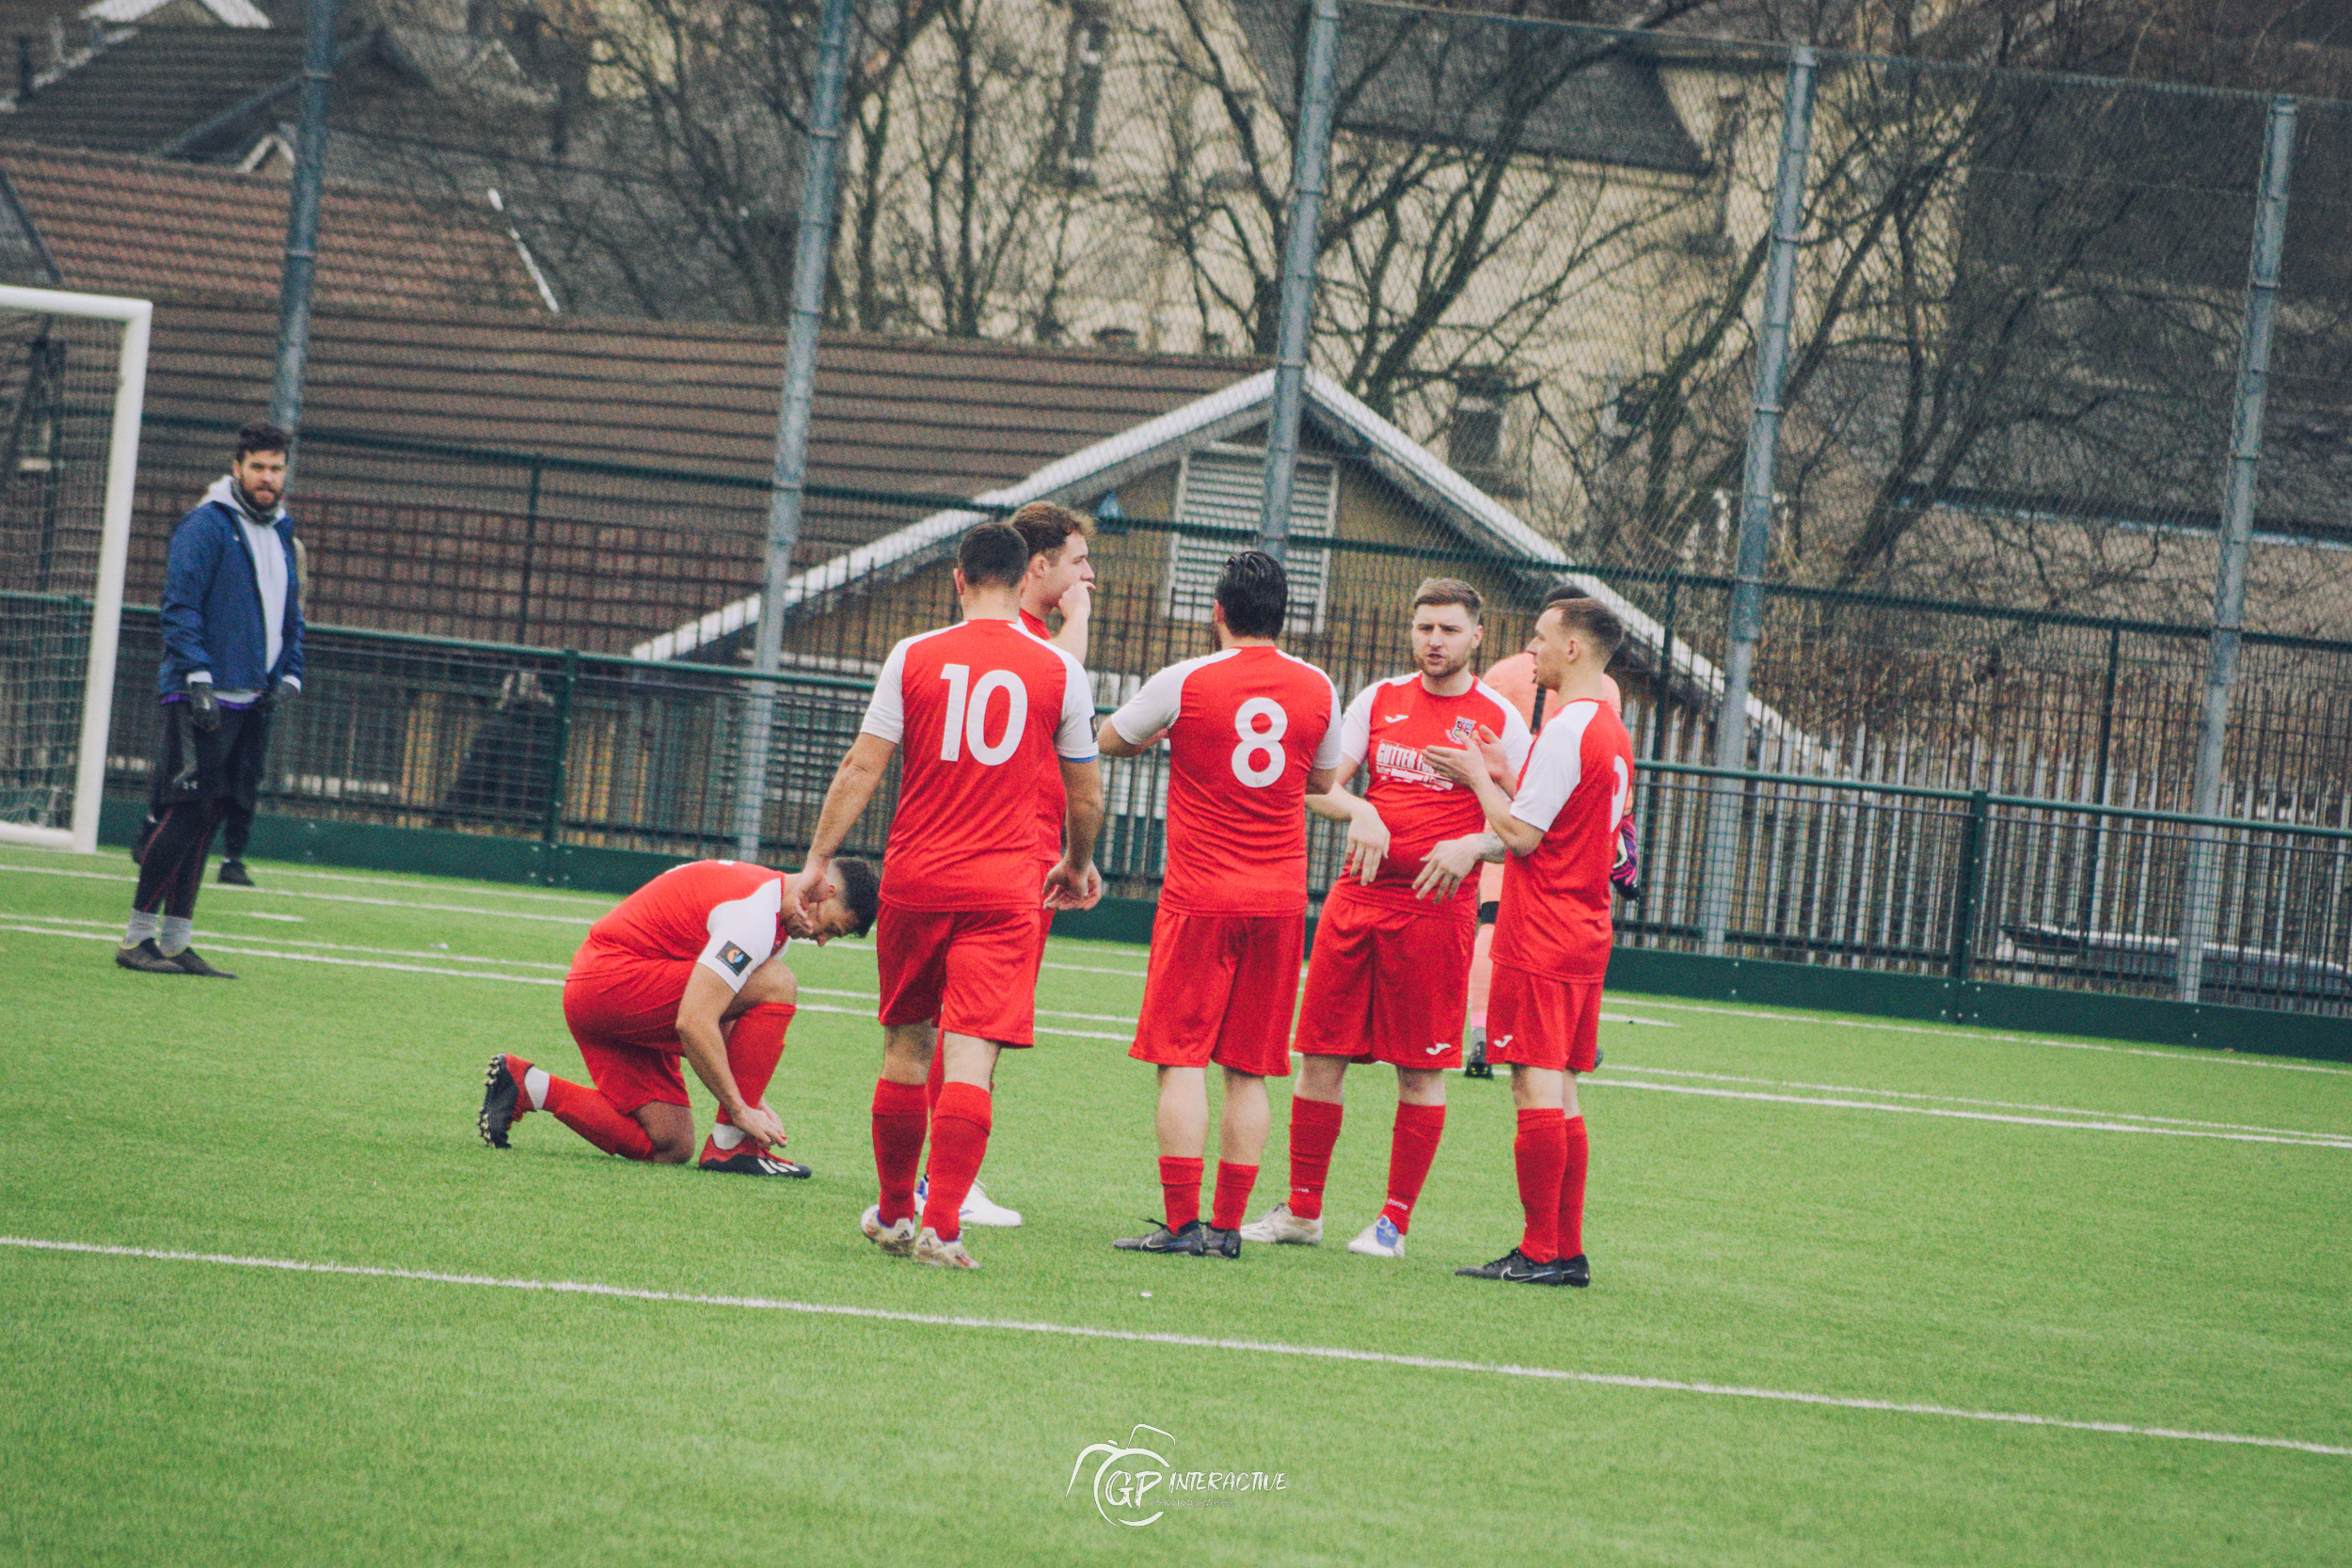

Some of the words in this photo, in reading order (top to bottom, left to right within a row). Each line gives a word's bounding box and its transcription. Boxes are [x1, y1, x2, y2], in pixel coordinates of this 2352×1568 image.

[940, 663, 1027, 766] 10
[1232, 697, 1288, 787] 8
[1376, 743, 1418, 768] GUTTER
